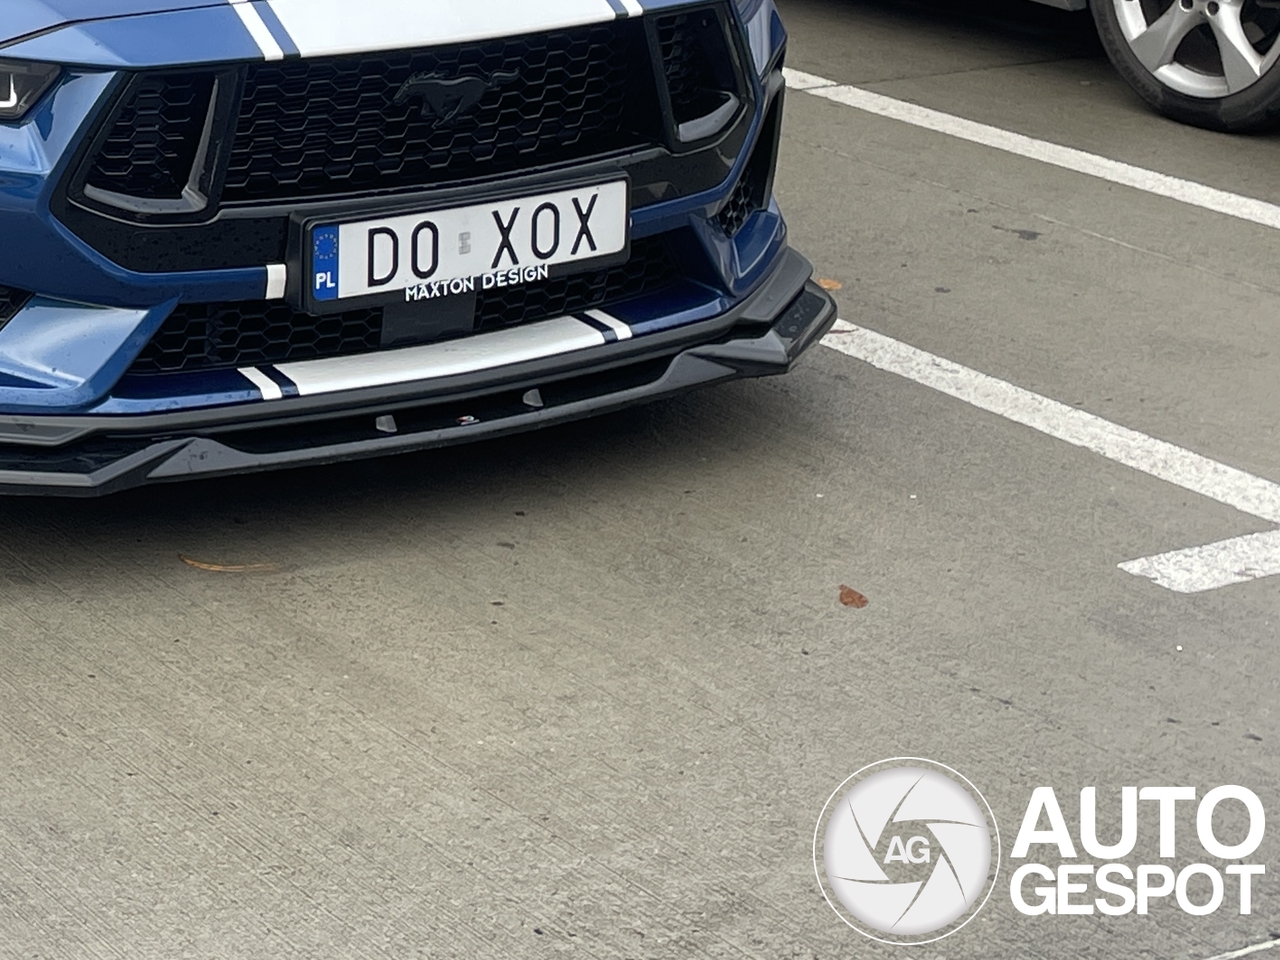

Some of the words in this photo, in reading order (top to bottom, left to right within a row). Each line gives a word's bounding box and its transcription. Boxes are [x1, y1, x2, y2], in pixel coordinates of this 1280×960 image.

[491, 193, 598, 269] XOX
[315, 271, 336, 290] PL
[404, 275, 475, 302] MAXTON
[482, 264, 549, 290] DESIGN
